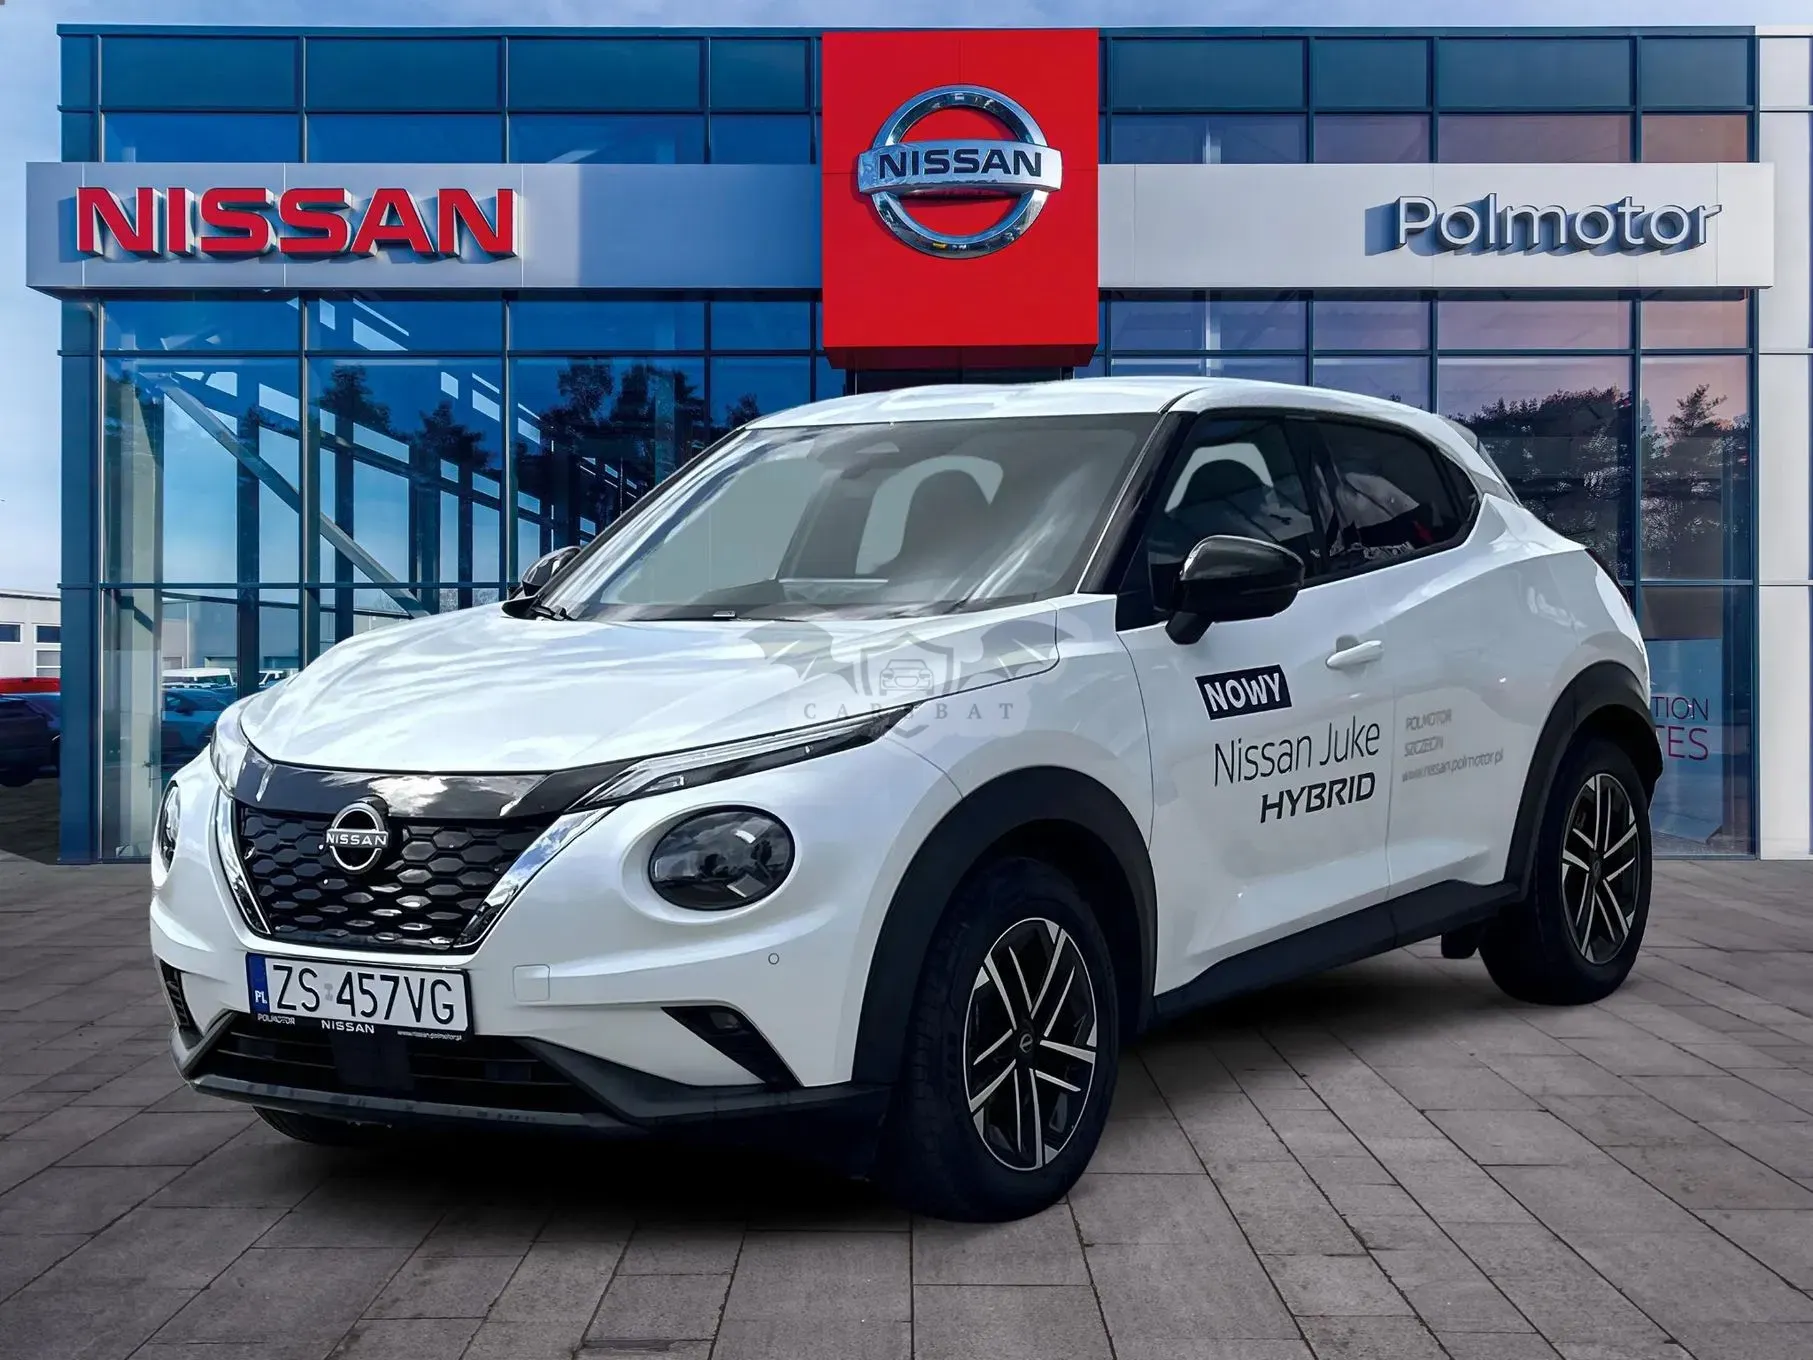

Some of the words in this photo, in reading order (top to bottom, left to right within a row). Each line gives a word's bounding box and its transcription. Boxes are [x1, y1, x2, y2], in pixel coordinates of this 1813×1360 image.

[879, 149, 1042, 179] NISSAN
[76, 186, 517, 257] NISSAN
[1396, 193, 1722, 249] Polmotor
[1203, 672, 1281, 713] NOWY
[1405, 708, 1452, 731] POLMOTOR
[1213, 734, 1313, 787] Nissan
[1319, 715, 1381, 767] Juke
[1260, 771, 1376, 824] HYBRID
[326, 832, 387, 846] NISSAN
[254, 989, 268, 1005] PL
[272, 964, 321, 1013] ZS
[336, 971, 455, 1025] 457VG
[321, 1020, 375, 1034] NISSAN
